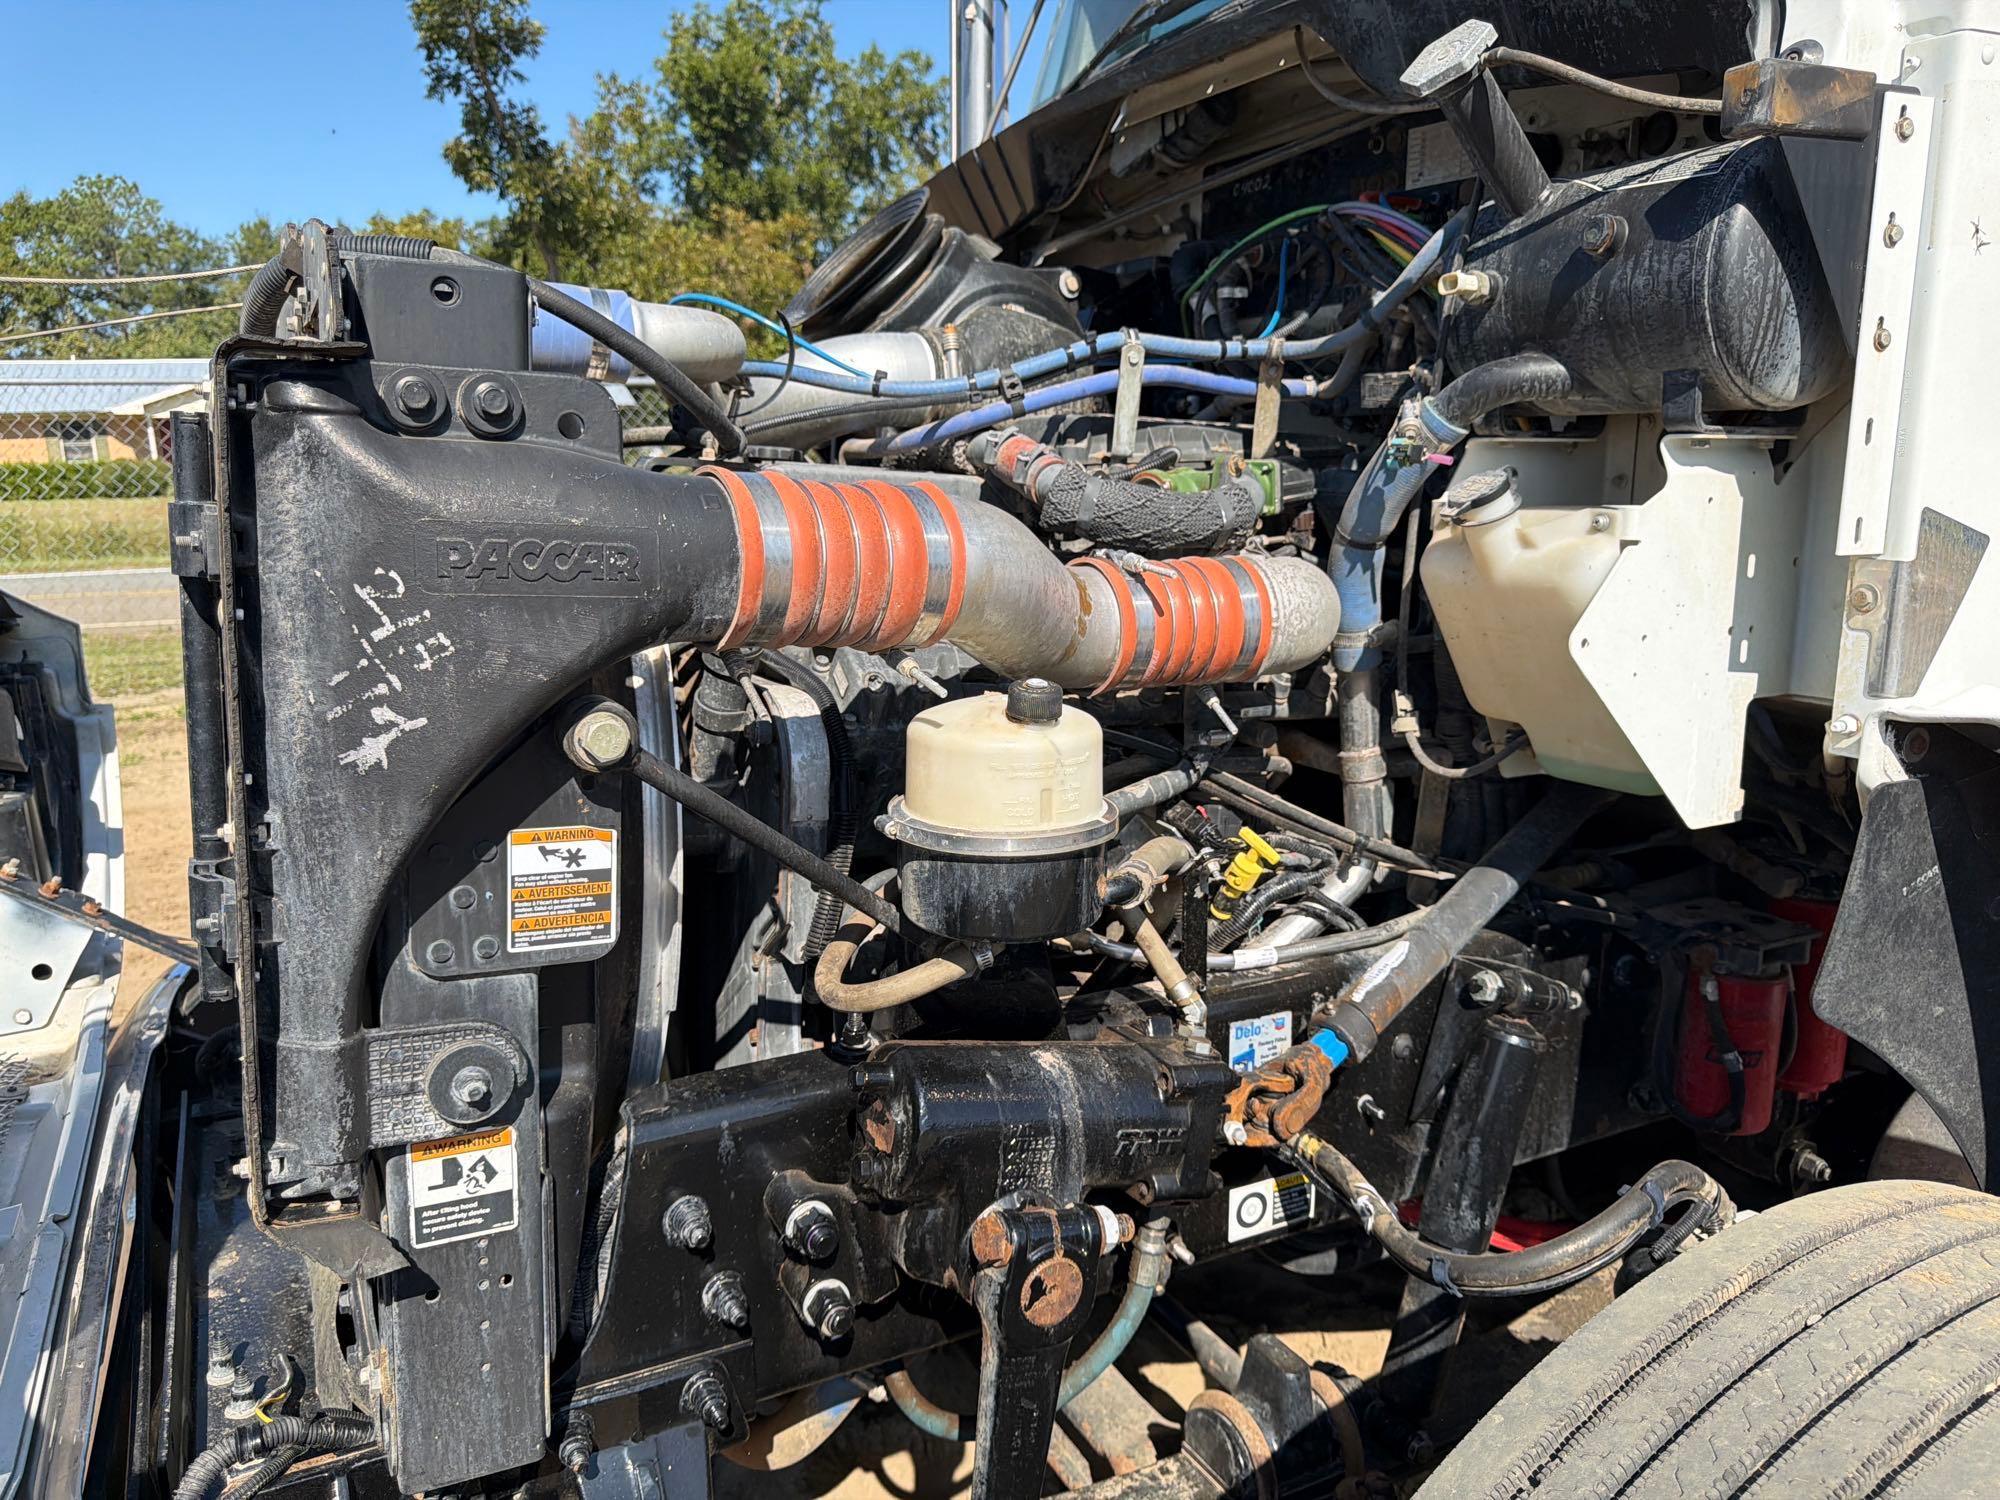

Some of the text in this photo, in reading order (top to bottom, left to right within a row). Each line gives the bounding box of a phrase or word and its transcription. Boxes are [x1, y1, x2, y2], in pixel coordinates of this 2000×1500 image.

[435, 535, 641, 583] PACCAR
[544, 829, 595, 841] WARNING
[528, 883, 610, 898] AVERTISSEMENT
[533, 913, 605, 927] ADVERTENCIA
[1235, 1022, 1261, 1040] Delo
[432, 1134, 502, 1154] WARNING
[421, 1209, 439, 1218] After
[460, 1201, 479, 1210] hood
[468, 1207, 491, 1217] device
[422, 1226, 431, 1234] to
